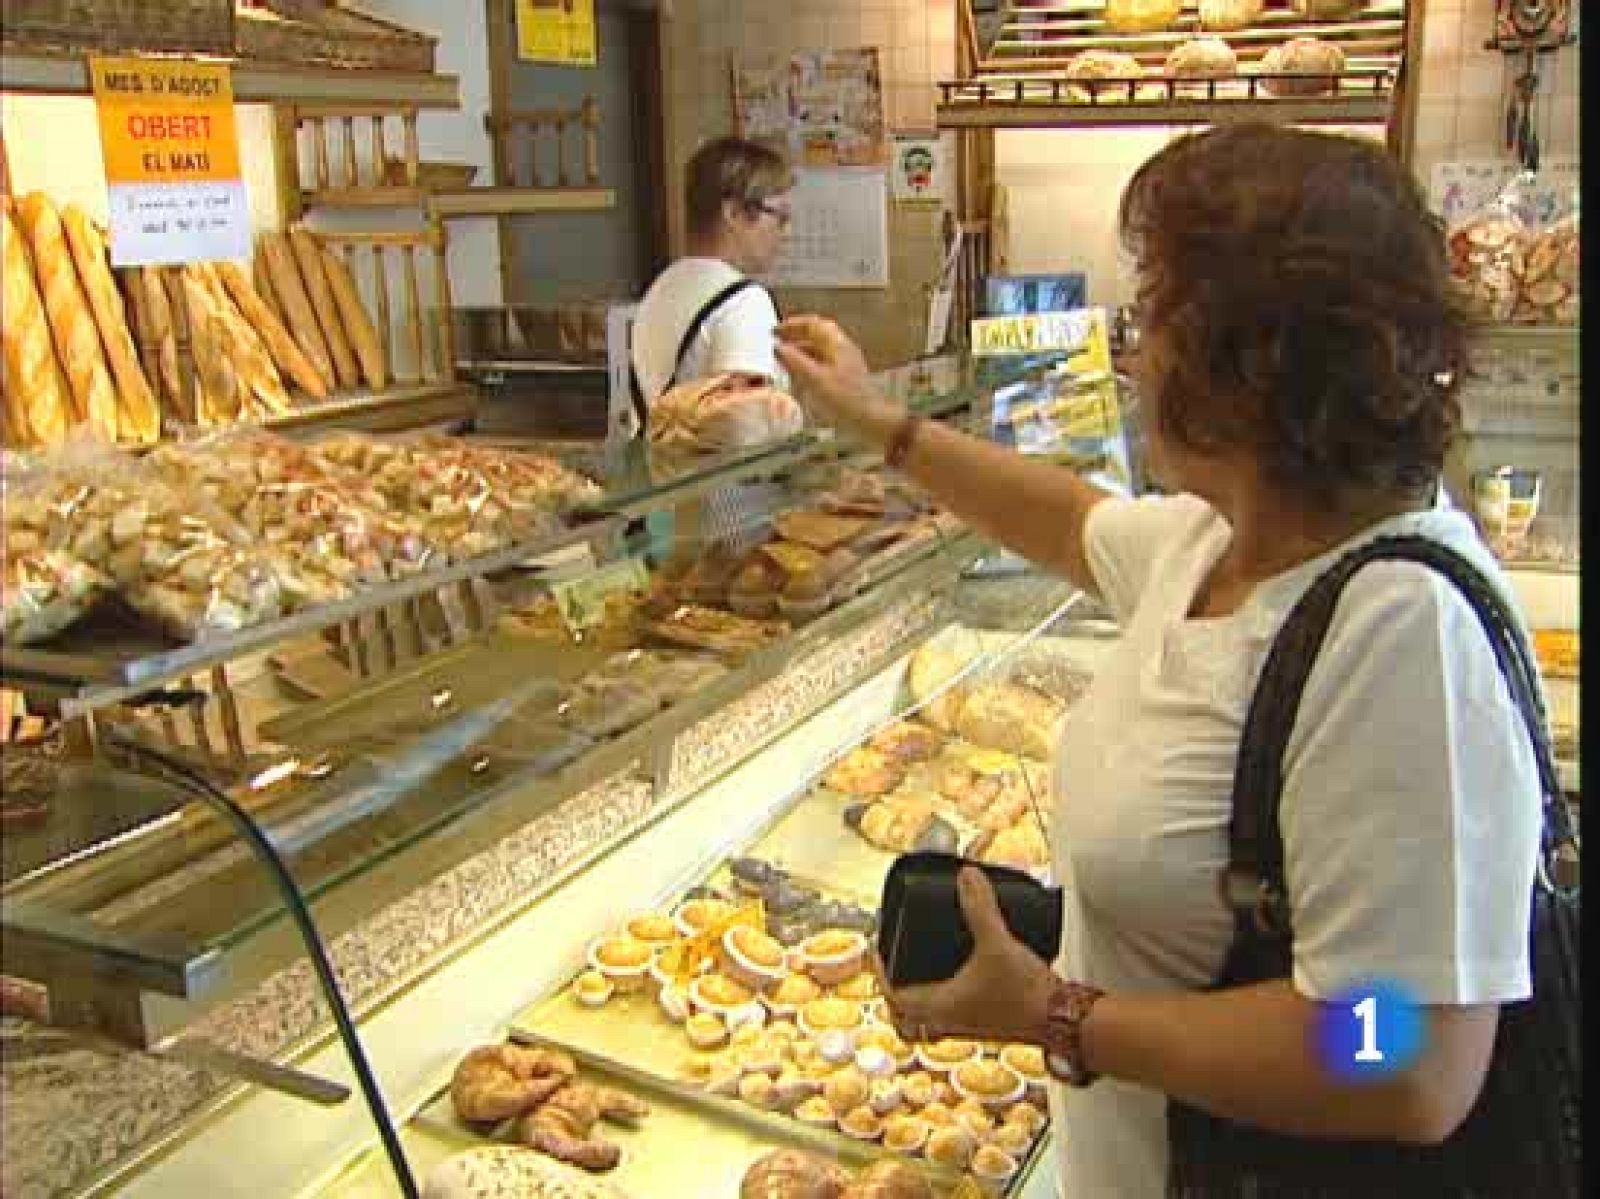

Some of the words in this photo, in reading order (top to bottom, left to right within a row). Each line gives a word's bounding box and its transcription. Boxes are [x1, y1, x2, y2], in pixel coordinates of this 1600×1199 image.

[104, 72, 143, 93] MES
[127, 115, 211, 140] OBERT
[142, 152, 167, 173] EL
